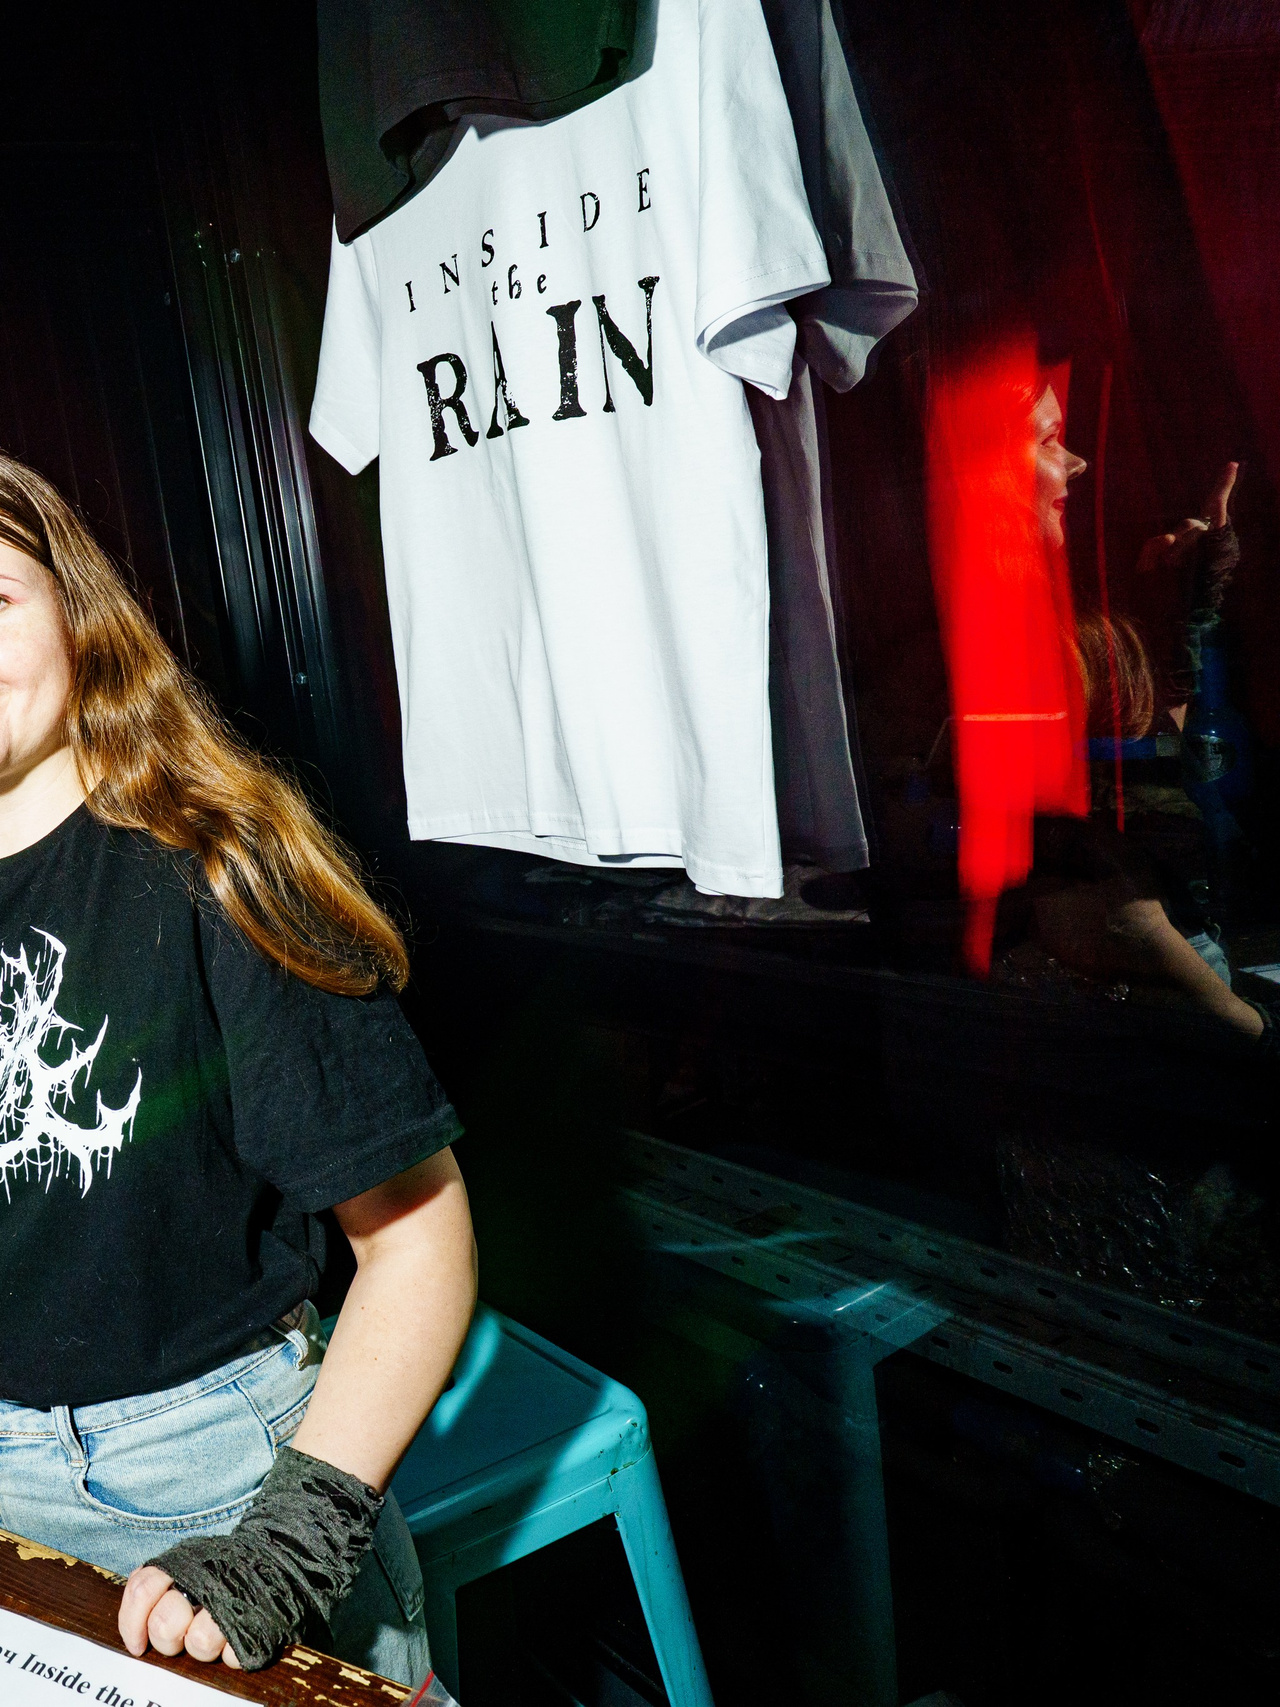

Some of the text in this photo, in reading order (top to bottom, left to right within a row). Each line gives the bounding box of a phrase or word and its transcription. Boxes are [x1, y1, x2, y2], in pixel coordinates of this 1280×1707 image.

[404, 168, 652, 313] INSIDE
[491, 264, 548, 306] the
[416, 275, 660, 461] RAIN
[20, 1652, 92, 1695] Inside
[95, 1685, 135, 1707] the
